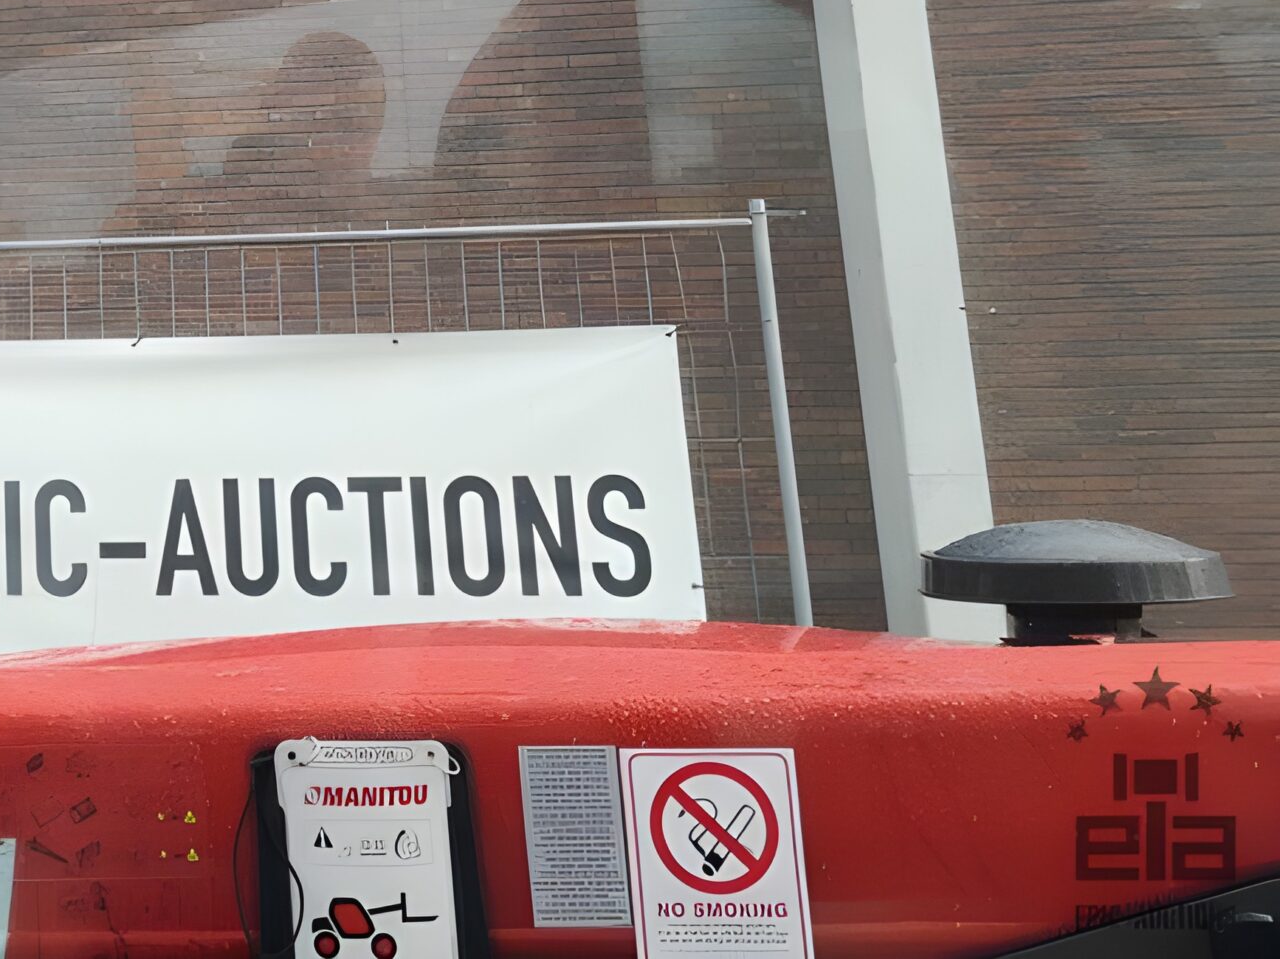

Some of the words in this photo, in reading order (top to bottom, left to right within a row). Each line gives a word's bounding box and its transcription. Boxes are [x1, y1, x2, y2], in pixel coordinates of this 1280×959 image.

[323, 784, 428, 807] MANITOU
[658, 903, 685, 917] NO
[694, 903, 788, 918] SMOKING
